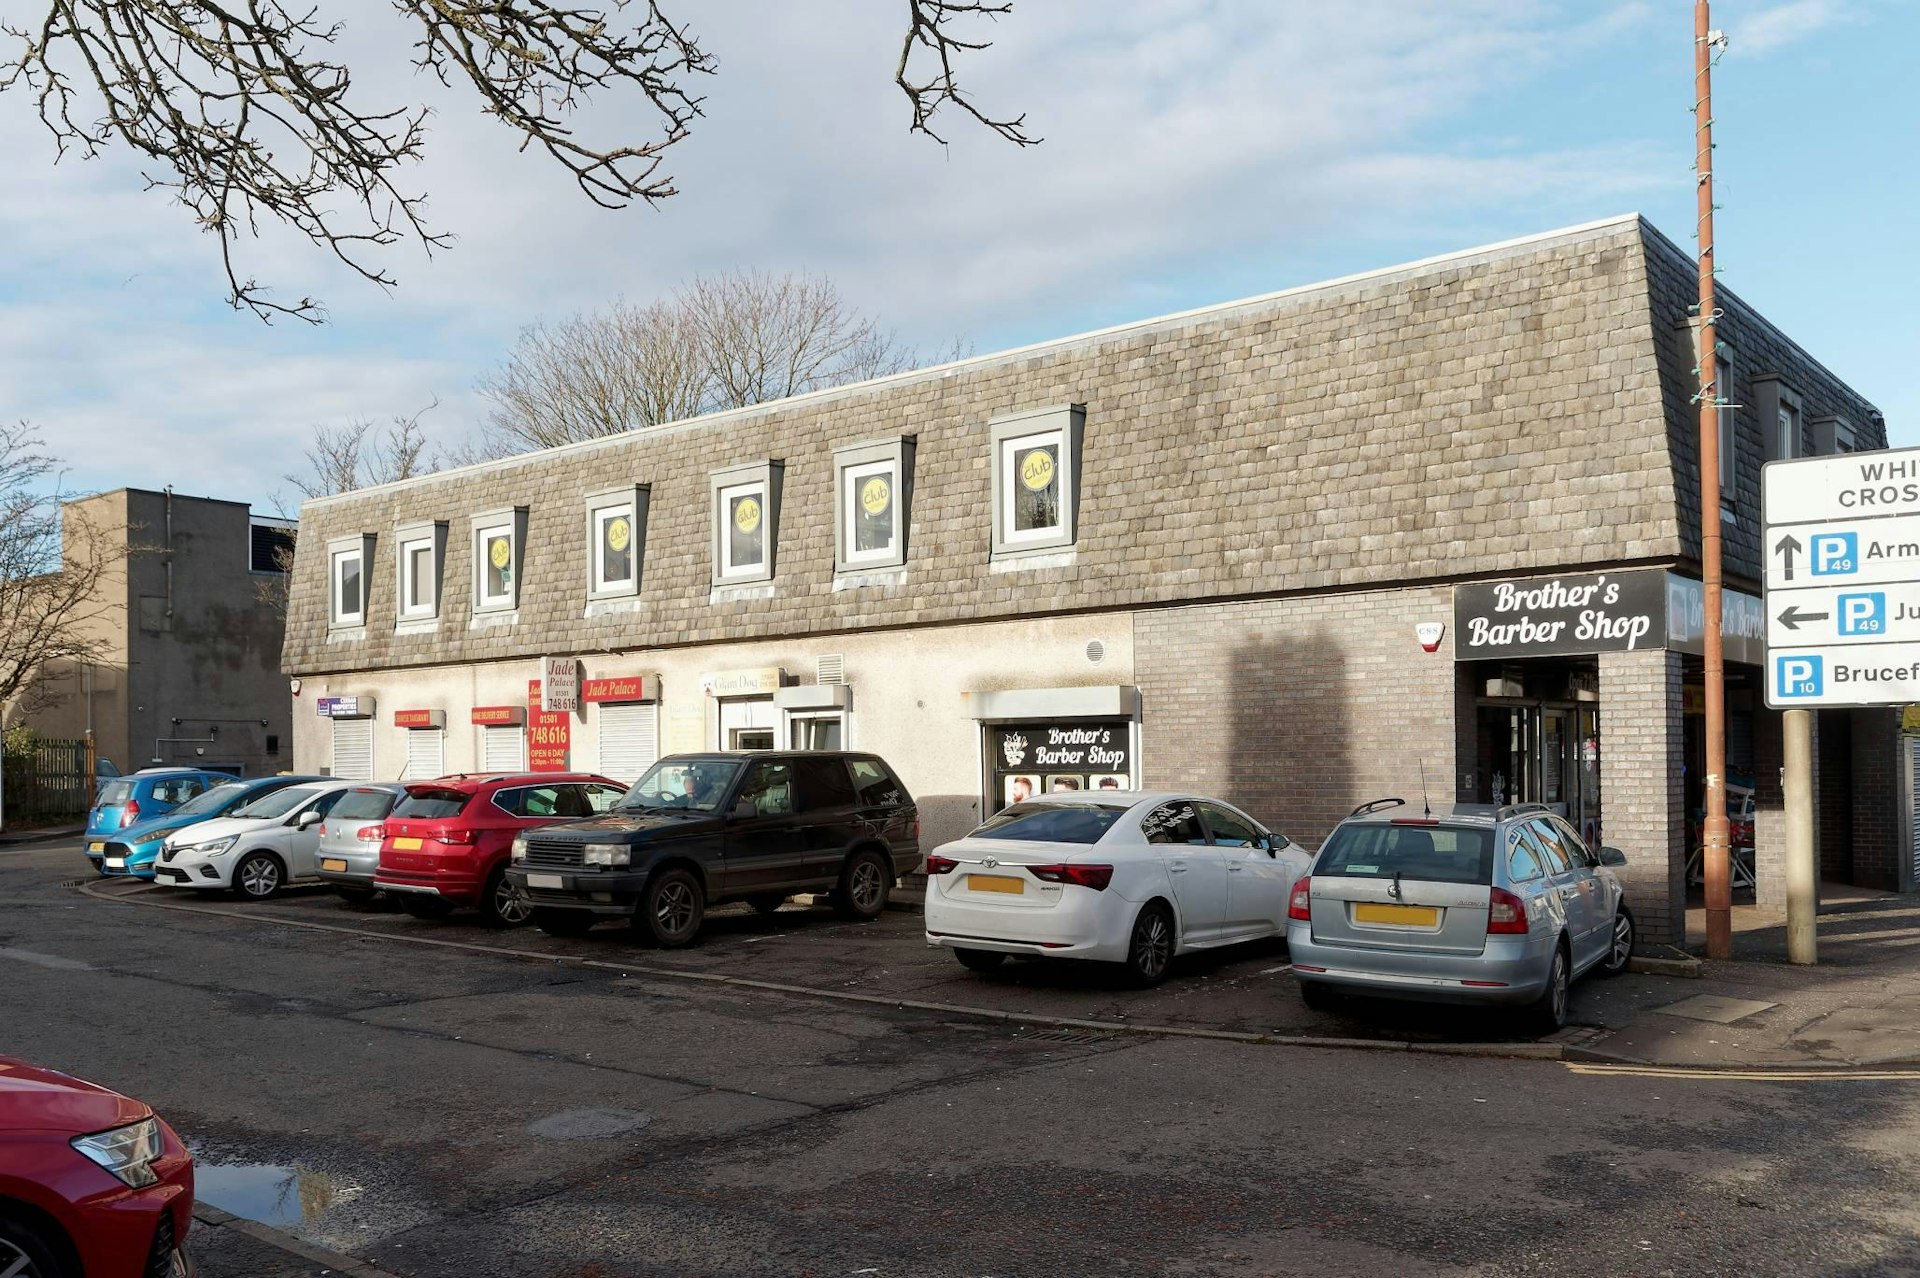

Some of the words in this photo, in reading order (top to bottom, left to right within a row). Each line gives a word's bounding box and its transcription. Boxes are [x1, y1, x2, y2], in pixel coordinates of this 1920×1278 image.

[1024, 458, 1051, 480] club
[1860, 459, 1920, 482] WHI
[864, 486, 888, 504] club
[1838, 484, 1919, 507] CROS
[1831, 560, 1851, 571] 49
[1866, 541, 1920, 559] Arm
[1493, 575, 1620, 613] Brother's
[1467, 616, 1566, 647] Barber
[1575, 610, 1650, 650] Shop
[1858, 619, 1879, 631] 49
[549, 660, 574, 675] Jade
[549, 677, 575, 687] Palace
[1799, 683, 1815, 694] 10
[1834, 662, 1920, 683] Brucef
[587, 683, 606, 696] Jade
[608, 681, 636, 695] Palace
[549, 698, 562, 709] 748
[563, 698, 576, 709] 616
[540, 715, 557, 723] 01501
[531, 726, 547, 744] 748
[549, 726, 566, 744] 616
[1048, 726, 1111, 744] Brother's
[530, 749, 547, 757] OPEN
[1035, 746, 1084, 764] Barber
[1088, 745, 1125, 771] Shop
